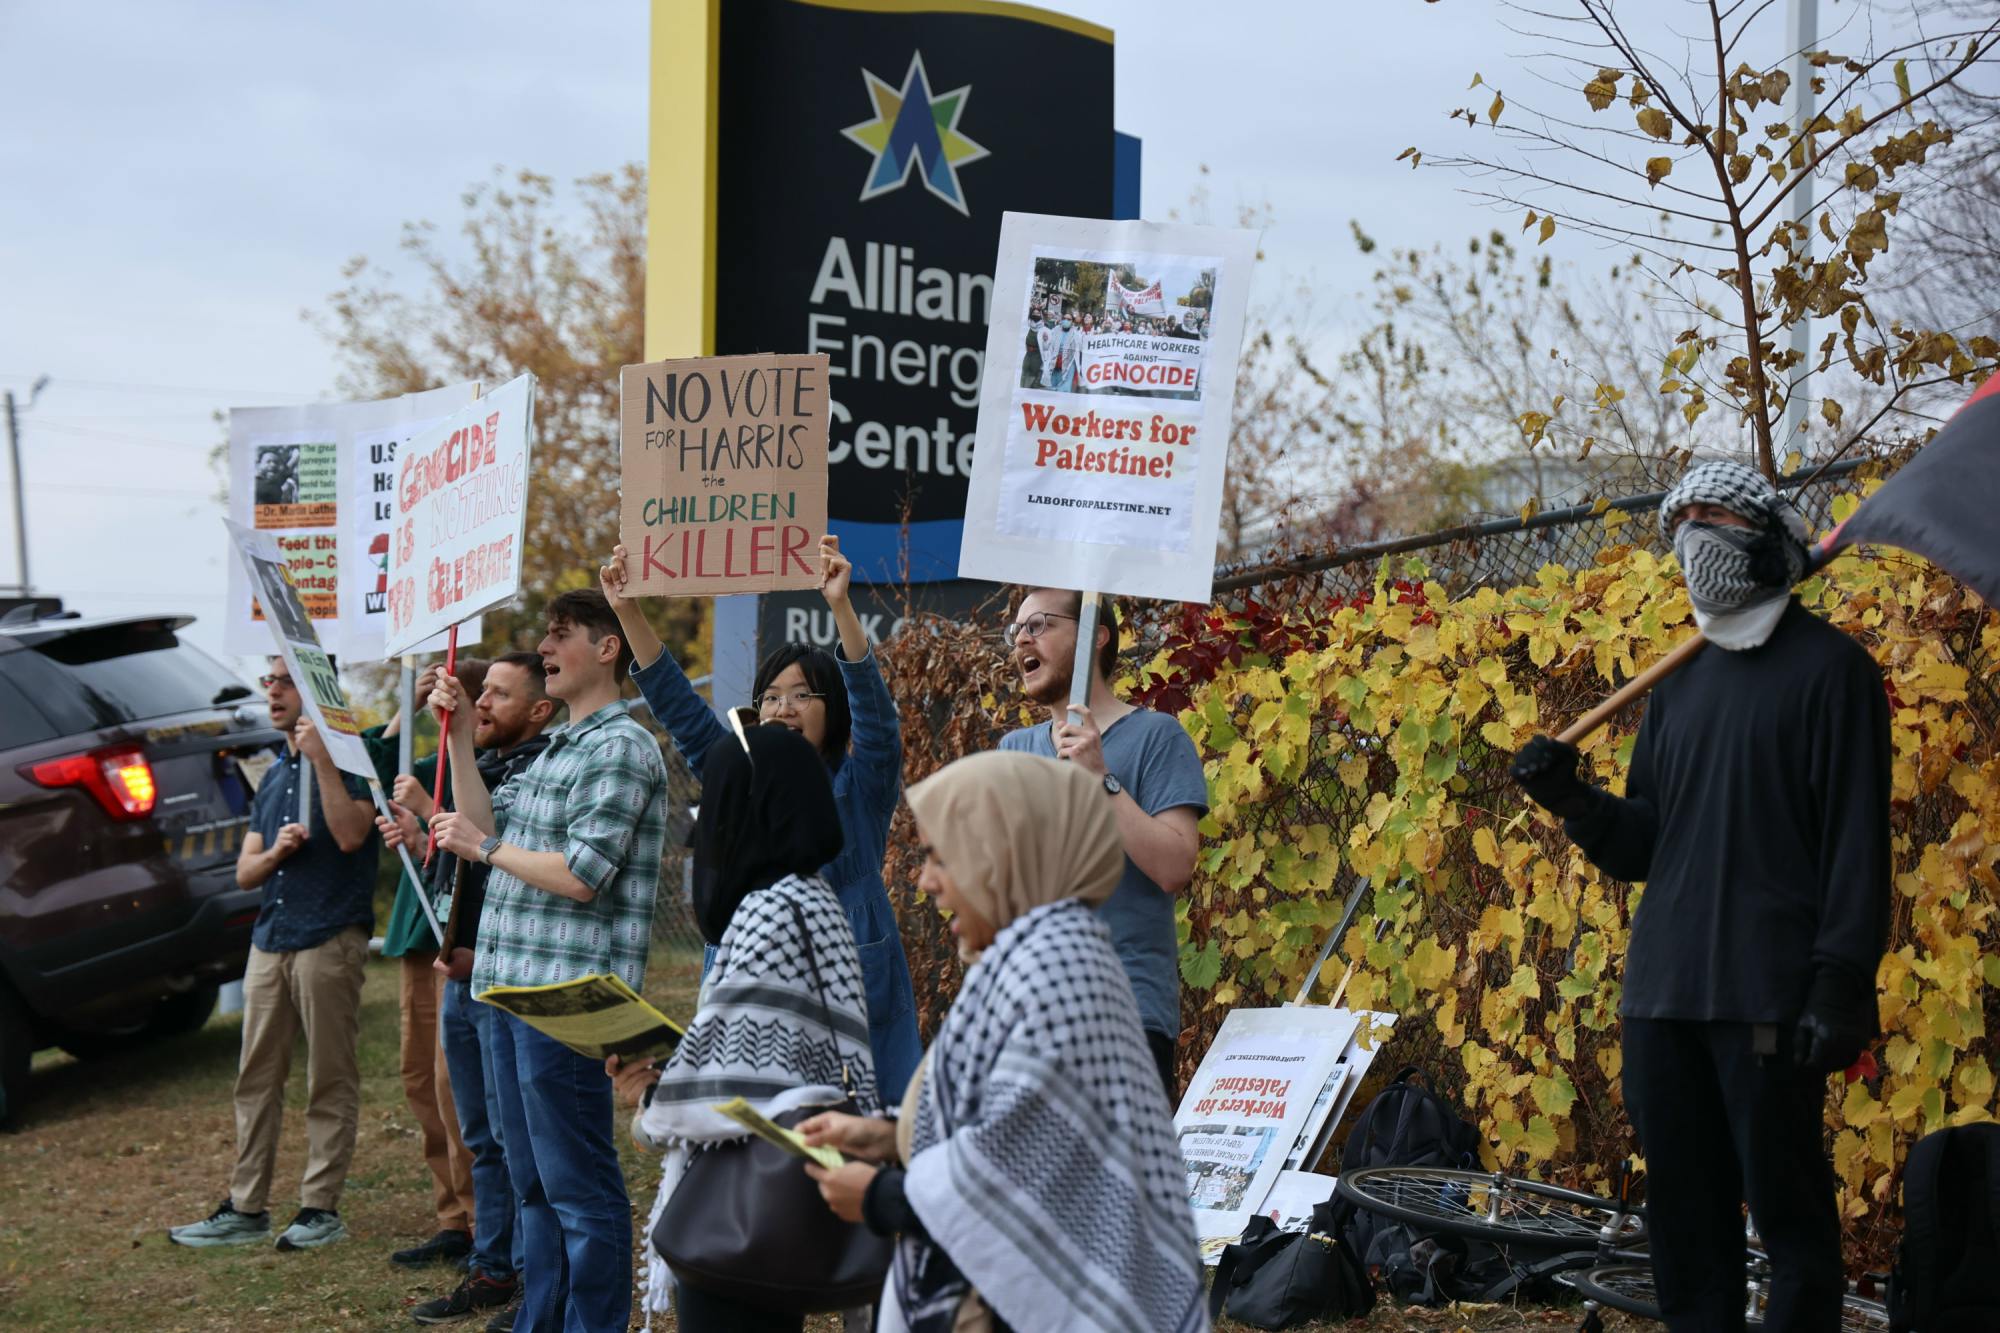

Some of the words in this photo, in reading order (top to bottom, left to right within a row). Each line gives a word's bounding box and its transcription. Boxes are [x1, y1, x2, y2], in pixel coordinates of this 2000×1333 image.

[810, 236, 994, 326] Allian
[808, 313, 985, 408] Energ
[1087, 338, 1149, 353] HEALTHCARE
[1151, 341, 1200, 355] WORKERS
[1123, 353, 1159, 363] AGAINST
[1086, 362, 1196, 387] GENOCIDE
[645, 372, 712, 424] NO
[720, 367, 815, 418] VOTE
[828, 399, 974, 478] Cente
[1021, 402, 1142, 441] Workers
[1149, 414, 1197, 447] for
[399, 411, 500, 514] GENOCIDE
[645, 428, 676, 450] FOR
[679, 424, 808, 471] HARRIS
[1035, 439, 1174, 479] Palestine!
[702, 475, 726, 488] the
[309, 504, 336, 515] Luthe
[395, 517, 414, 569] IS
[429, 452, 523, 549] NOTHING
[643, 492, 795, 527] CHILDREN
[1027, 494, 1172, 516] LABORFORPALESTINE.NET
[277, 536, 310, 551] Feed
[642, 525, 816, 581] KILLER
[388, 576, 416, 636] TO
[427, 533, 514, 614] CELEBRATE
[786, 607, 884, 646] RUK
[1225, 1054, 1307, 1063] LABORFORPALESTINE.NET
[1209, 1077, 1292, 1097] Palestine!
[1193, 1099, 1217, 1117] for
[1217, 1097, 1288, 1120] Workers
[1214, 1149, 1250, 1161] HEALTHCARE
[1222, 1138, 1245, 1149] PEOPLE
